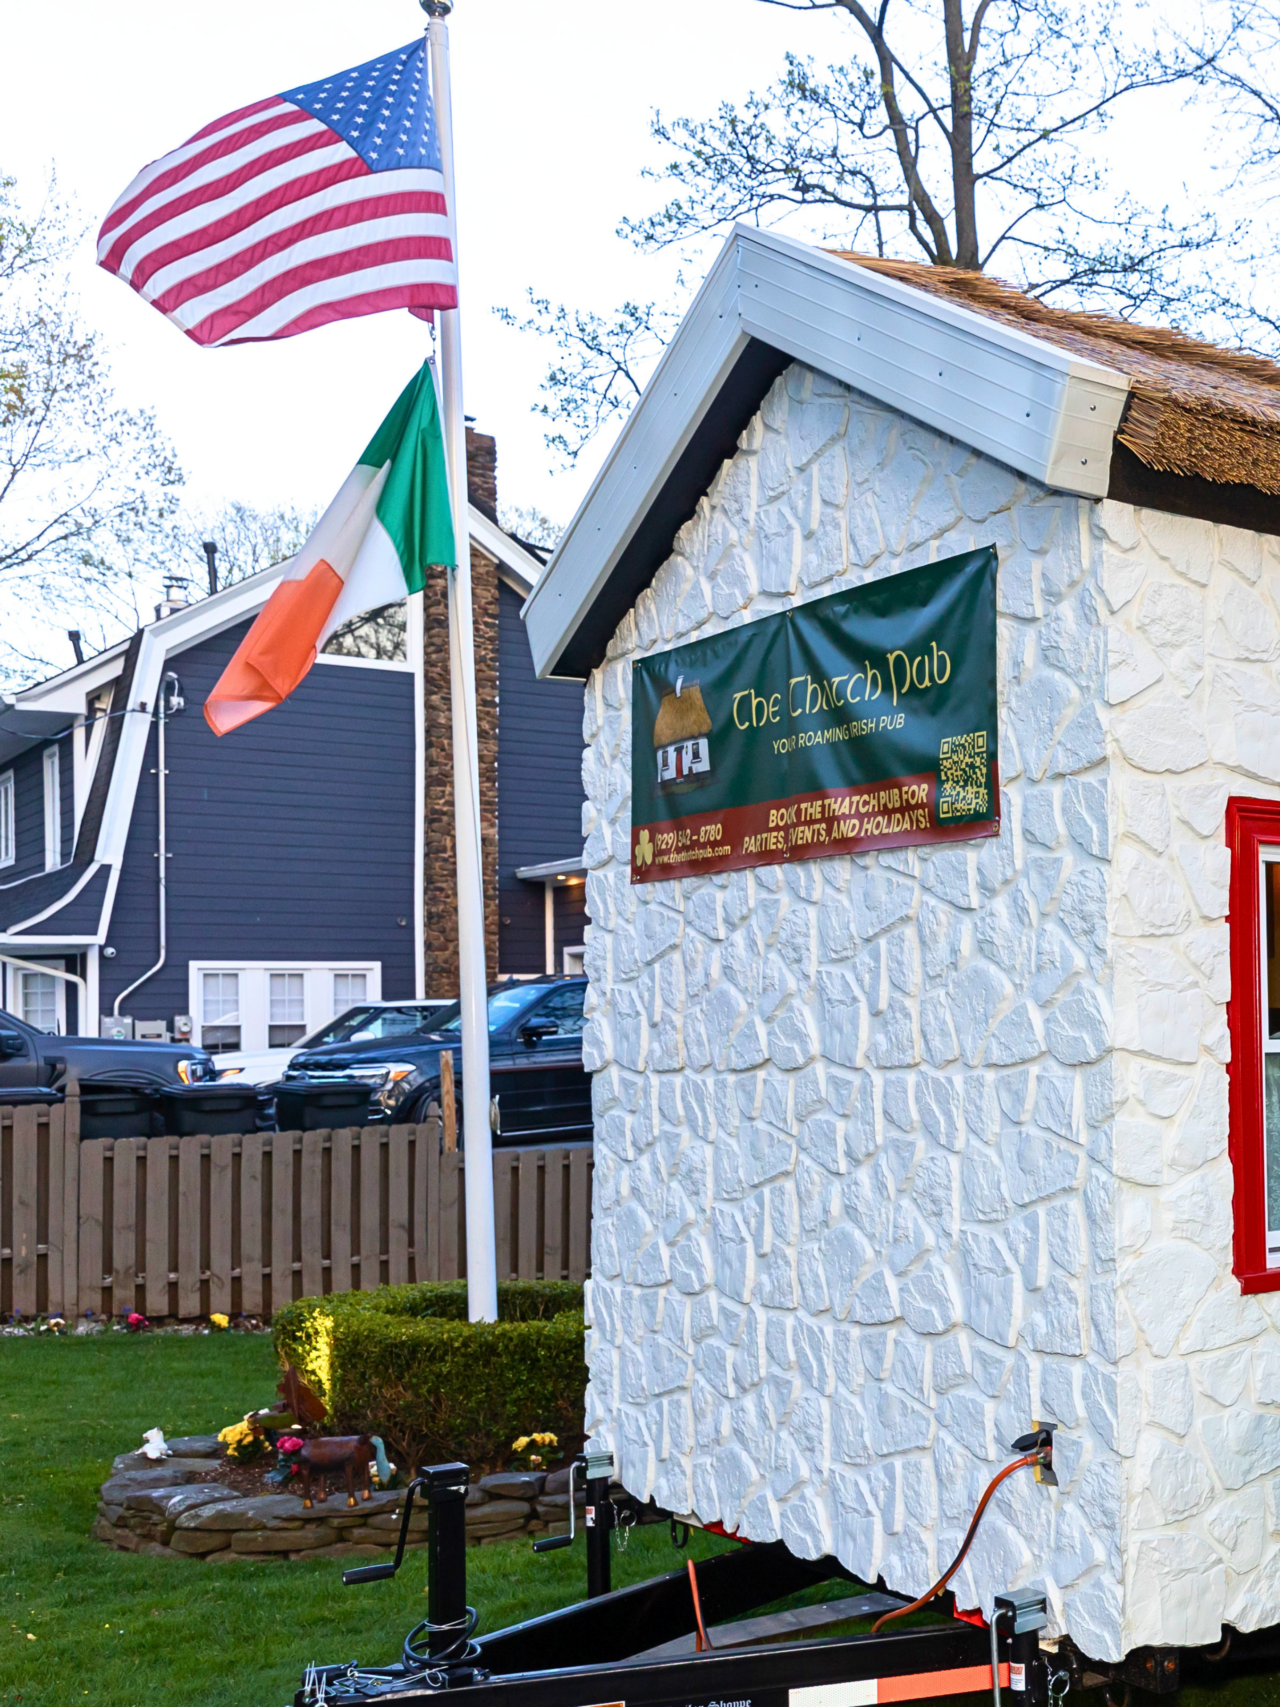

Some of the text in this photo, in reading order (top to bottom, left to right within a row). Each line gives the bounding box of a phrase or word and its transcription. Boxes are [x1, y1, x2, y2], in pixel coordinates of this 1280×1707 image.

[732, 641, 951, 730] The Thatch Pub
[772, 713, 906, 755] YOUR ROAMING IRISH PUB
[768, 783, 929, 828] BOOK THE THATCH PUB FOR
[655, 830, 677, 854] (929)
[699, 823, 723, 843] 8780
[742, 808, 931, 854] PARTIES, EVENTS, AND HOLIDAYS!
